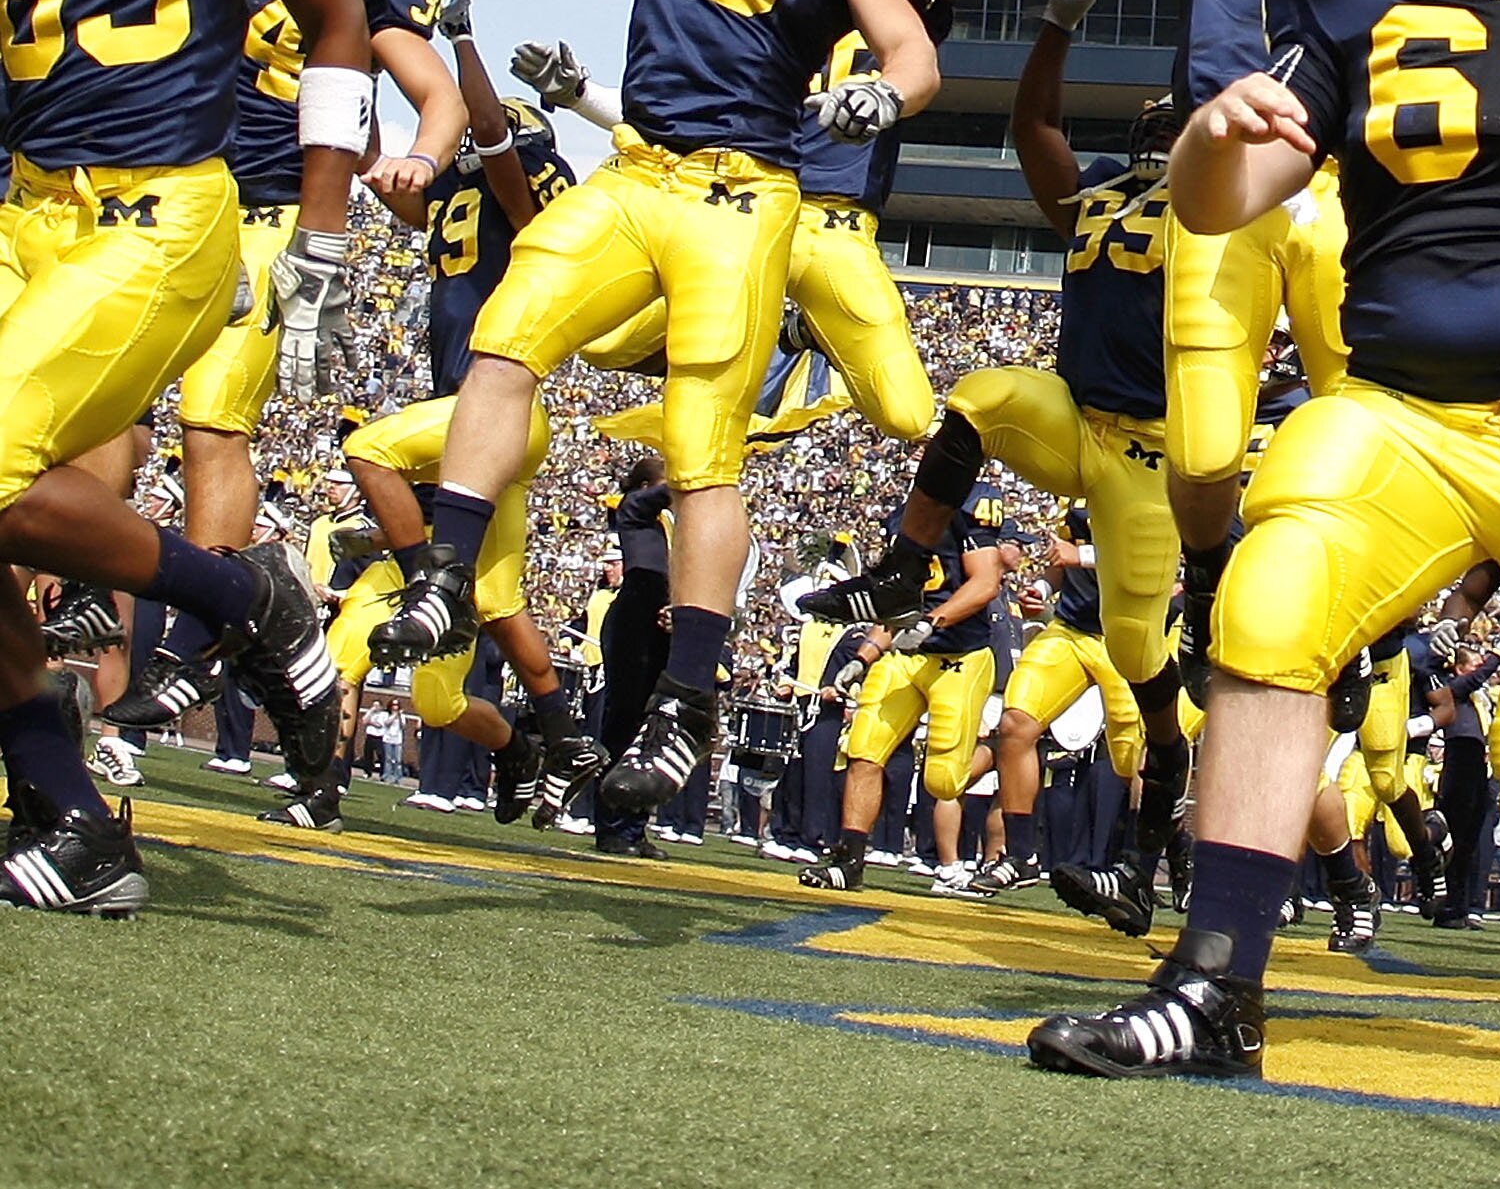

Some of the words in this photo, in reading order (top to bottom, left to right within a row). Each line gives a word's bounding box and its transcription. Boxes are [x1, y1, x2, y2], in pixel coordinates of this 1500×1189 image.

[100, 195, 160, 227] M
[703, 181, 756, 214] M
[242, 203, 282, 229] M
[824, 209, 861, 232] M
[1124, 438, 1166, 472] M
[974, 497, 1004, 528] 46
[939, 658, 963, 674] M
